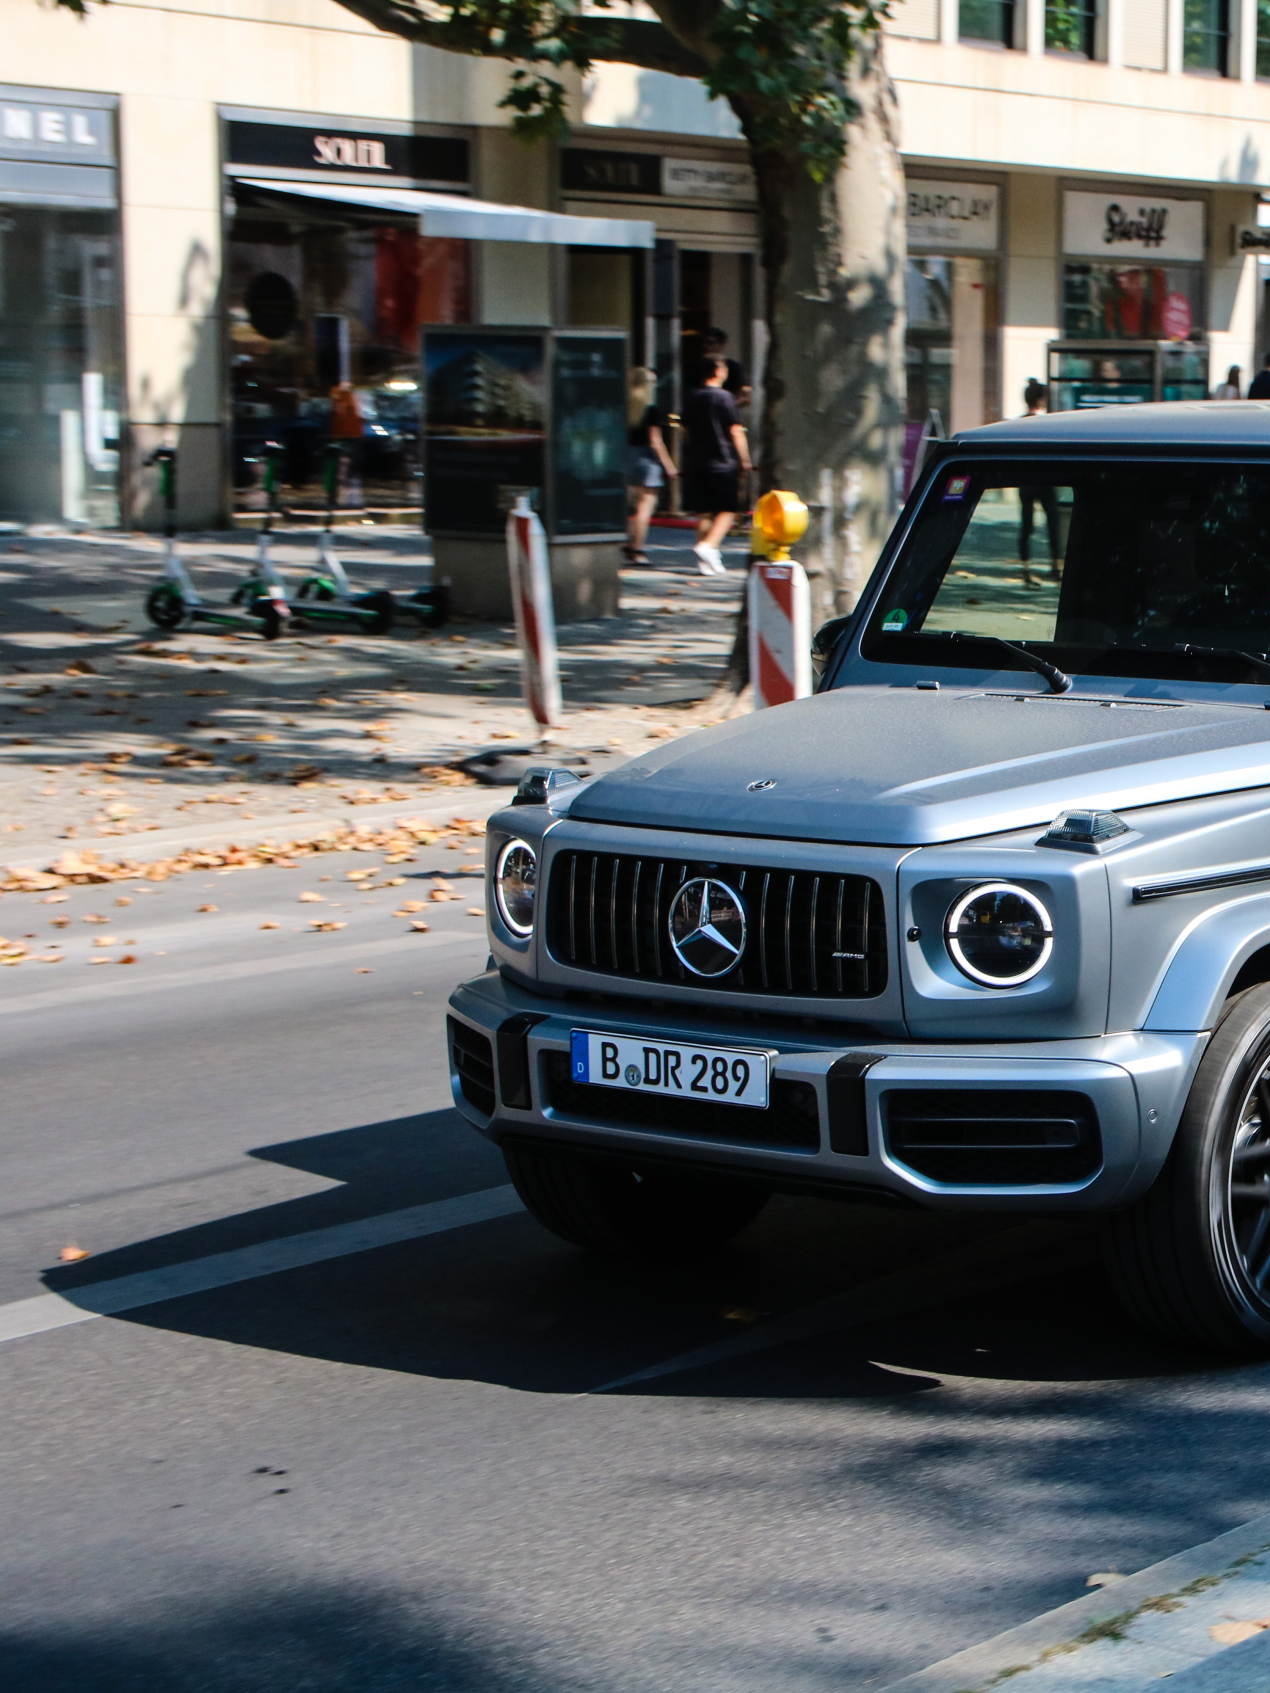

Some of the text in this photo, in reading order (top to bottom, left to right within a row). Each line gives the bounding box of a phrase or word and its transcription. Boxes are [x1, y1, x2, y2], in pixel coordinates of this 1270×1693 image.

[908, 193, 995, 221] BARCLAY
[1104, 203, 1168, 247] Steiff
[892, 609, 900, 623] 4
[577, 1062, 584, 1073] D
[601, 1041, 750, 1097] B DR 289
